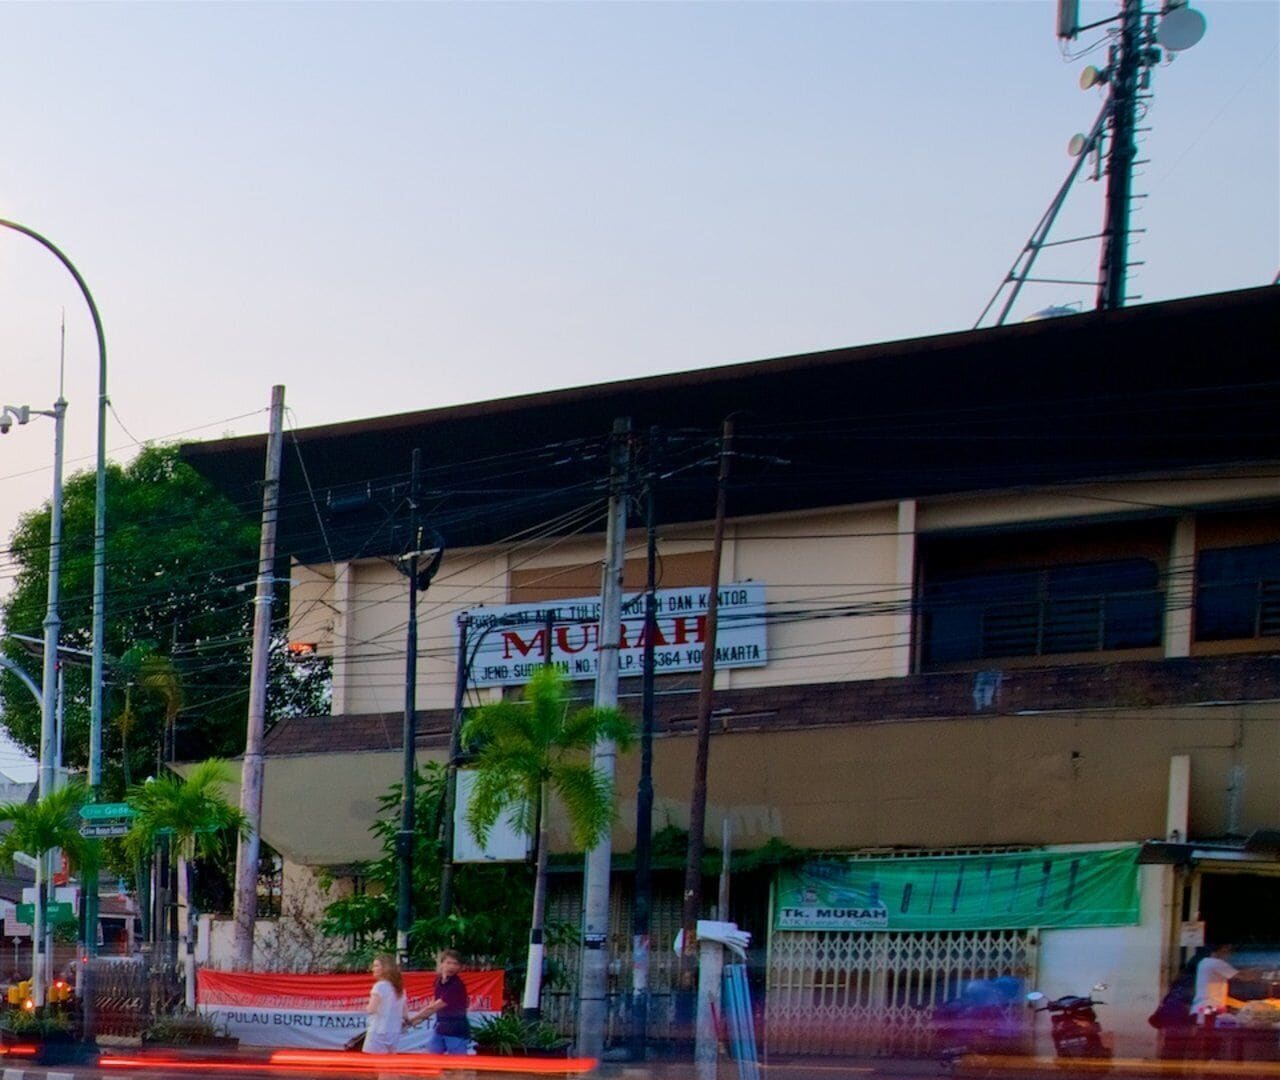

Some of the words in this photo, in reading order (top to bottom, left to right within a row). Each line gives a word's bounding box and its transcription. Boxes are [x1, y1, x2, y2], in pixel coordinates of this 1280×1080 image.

[669, 594, 692, 611] DAN
[816, 909, 887, 919] MURAH
[273, 1013, 314, 1027] BURU
[316, 1015, 367, 1029] TANAH
